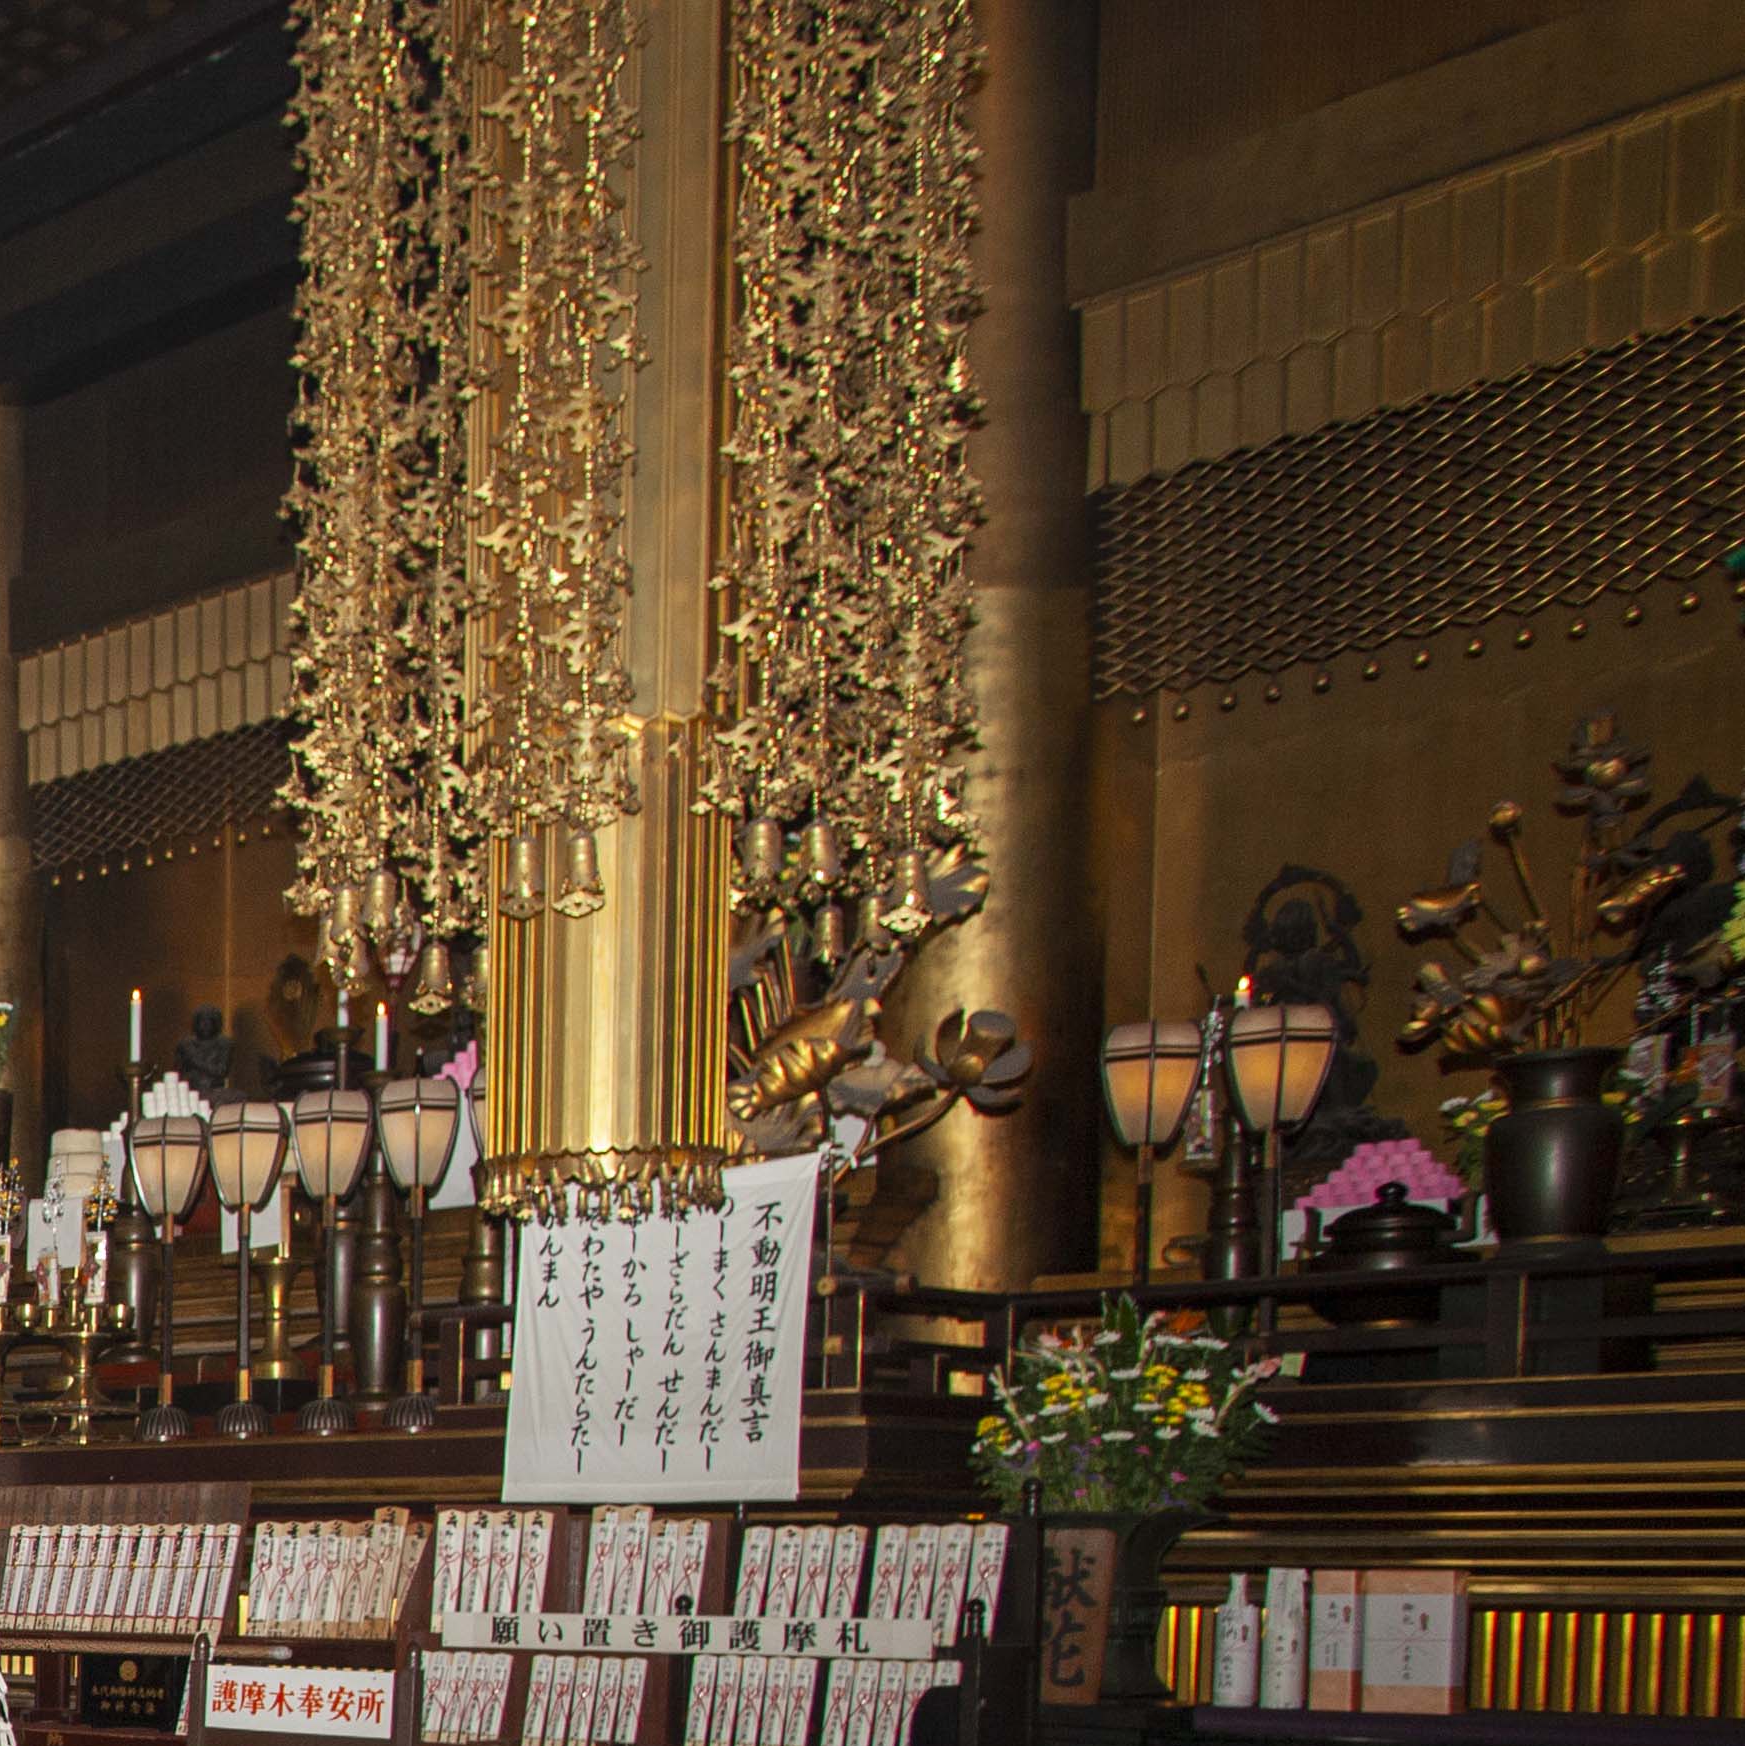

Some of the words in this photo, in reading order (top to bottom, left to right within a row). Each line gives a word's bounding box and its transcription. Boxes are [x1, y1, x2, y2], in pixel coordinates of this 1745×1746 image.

[620, 1207, 649, 1308] ーかろ
[661, 1206, 692, 1356] ーざらだん
[740, 1200, 784, 1443] 不動明王御真言
[569, 1319, 599, 1474] うんたらたー
[655, 1370, 686, 1474] せんだー
[697, 1310, 729, 1472] さんまんだー
[490, 1614, 871, 1656] 願い置き御護摩札
[211, 1680, 386, 1725] 護摩木奉安所
